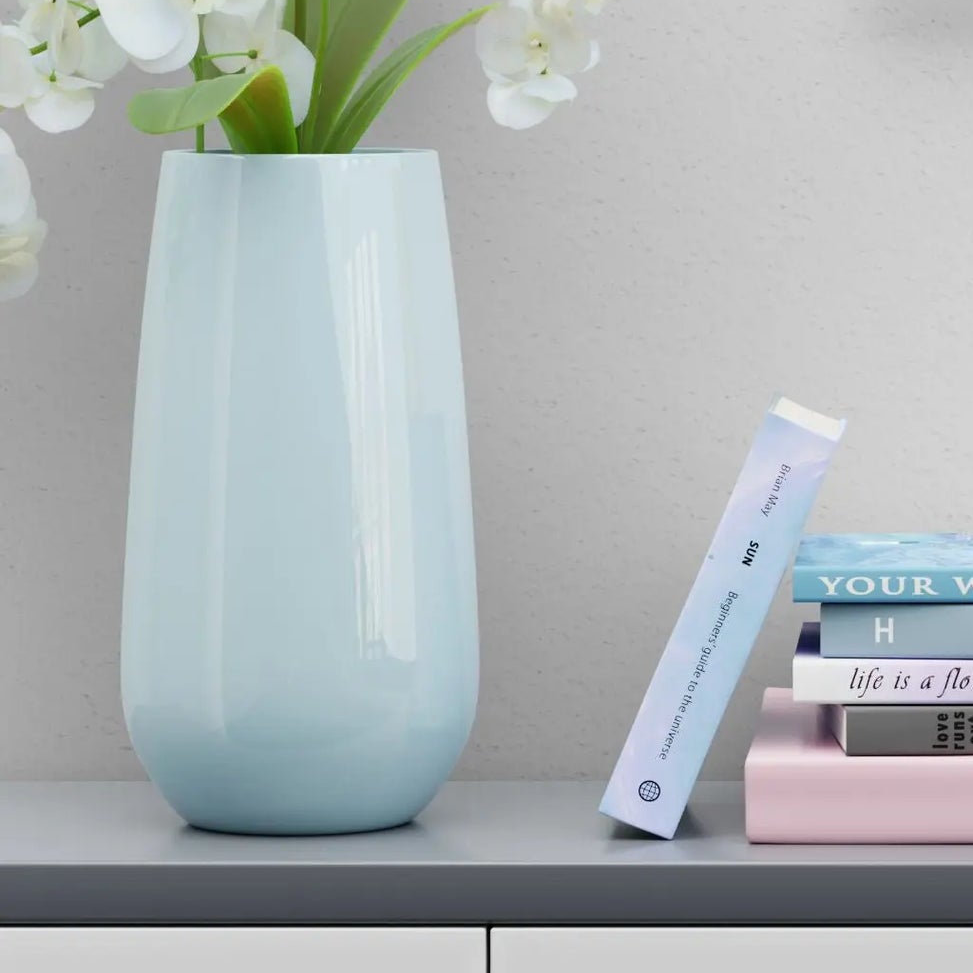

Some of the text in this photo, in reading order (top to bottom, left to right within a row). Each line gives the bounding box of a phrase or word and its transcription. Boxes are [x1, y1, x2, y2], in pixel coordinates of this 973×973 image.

[760, 463, 792, 517] Brian May
[741, 540, 760, 567] SUN
[818, 576, 939, 596] YOUR
[658, 591, 739, 760] Beginners' guide to the universe
[849, 667, 884, 698] life
[894, 671, 911, 690] is
[920, 675, 935, 690] a
[932, 713, 949, 749] love
[953, 711, 965, 750] runs
